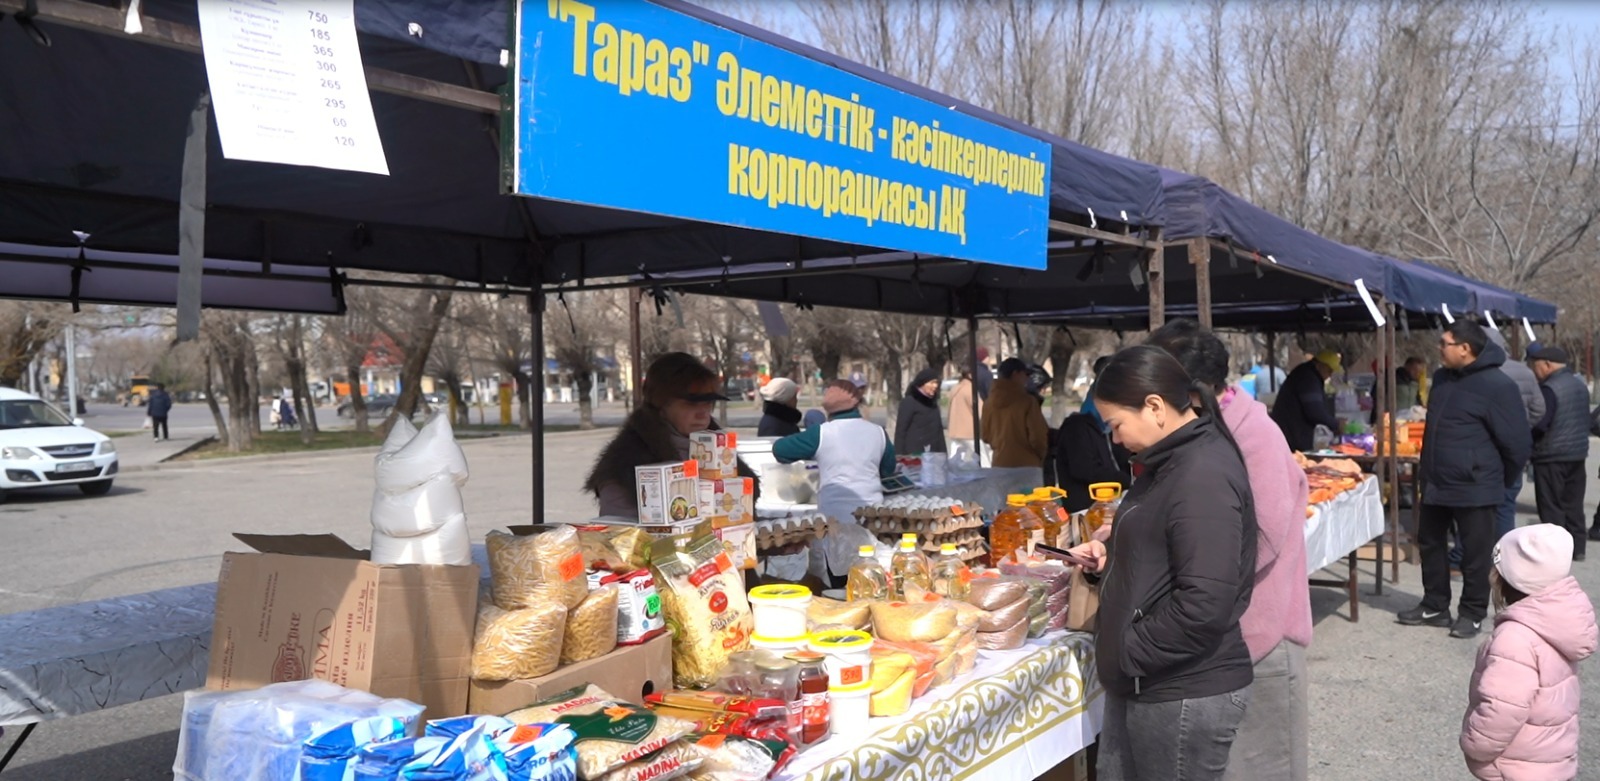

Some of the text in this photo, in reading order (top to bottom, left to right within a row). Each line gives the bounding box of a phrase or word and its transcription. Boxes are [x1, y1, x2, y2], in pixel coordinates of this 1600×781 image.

[307, 10, 328, 24] 750
[310, 28, 331, 41] 185
[313, 45, 334, 57] 365
[316, 61, 337, 73] 300
[320, 78, 341, 90] 265
[324, 98, 346, 109] 295
[548, 0, 709, 102] "Тараз"
[716, 51, 875, 153] Әлеметтік
[892, 116, 1045, 197] кәсіпкерлерлік
[333, 117, 347, 128] 60
[335, 136, 355, 147] 120
[728, 143, 966, 245] корпорациясы АҚ
[636, 756, 681, 781] MADINA
